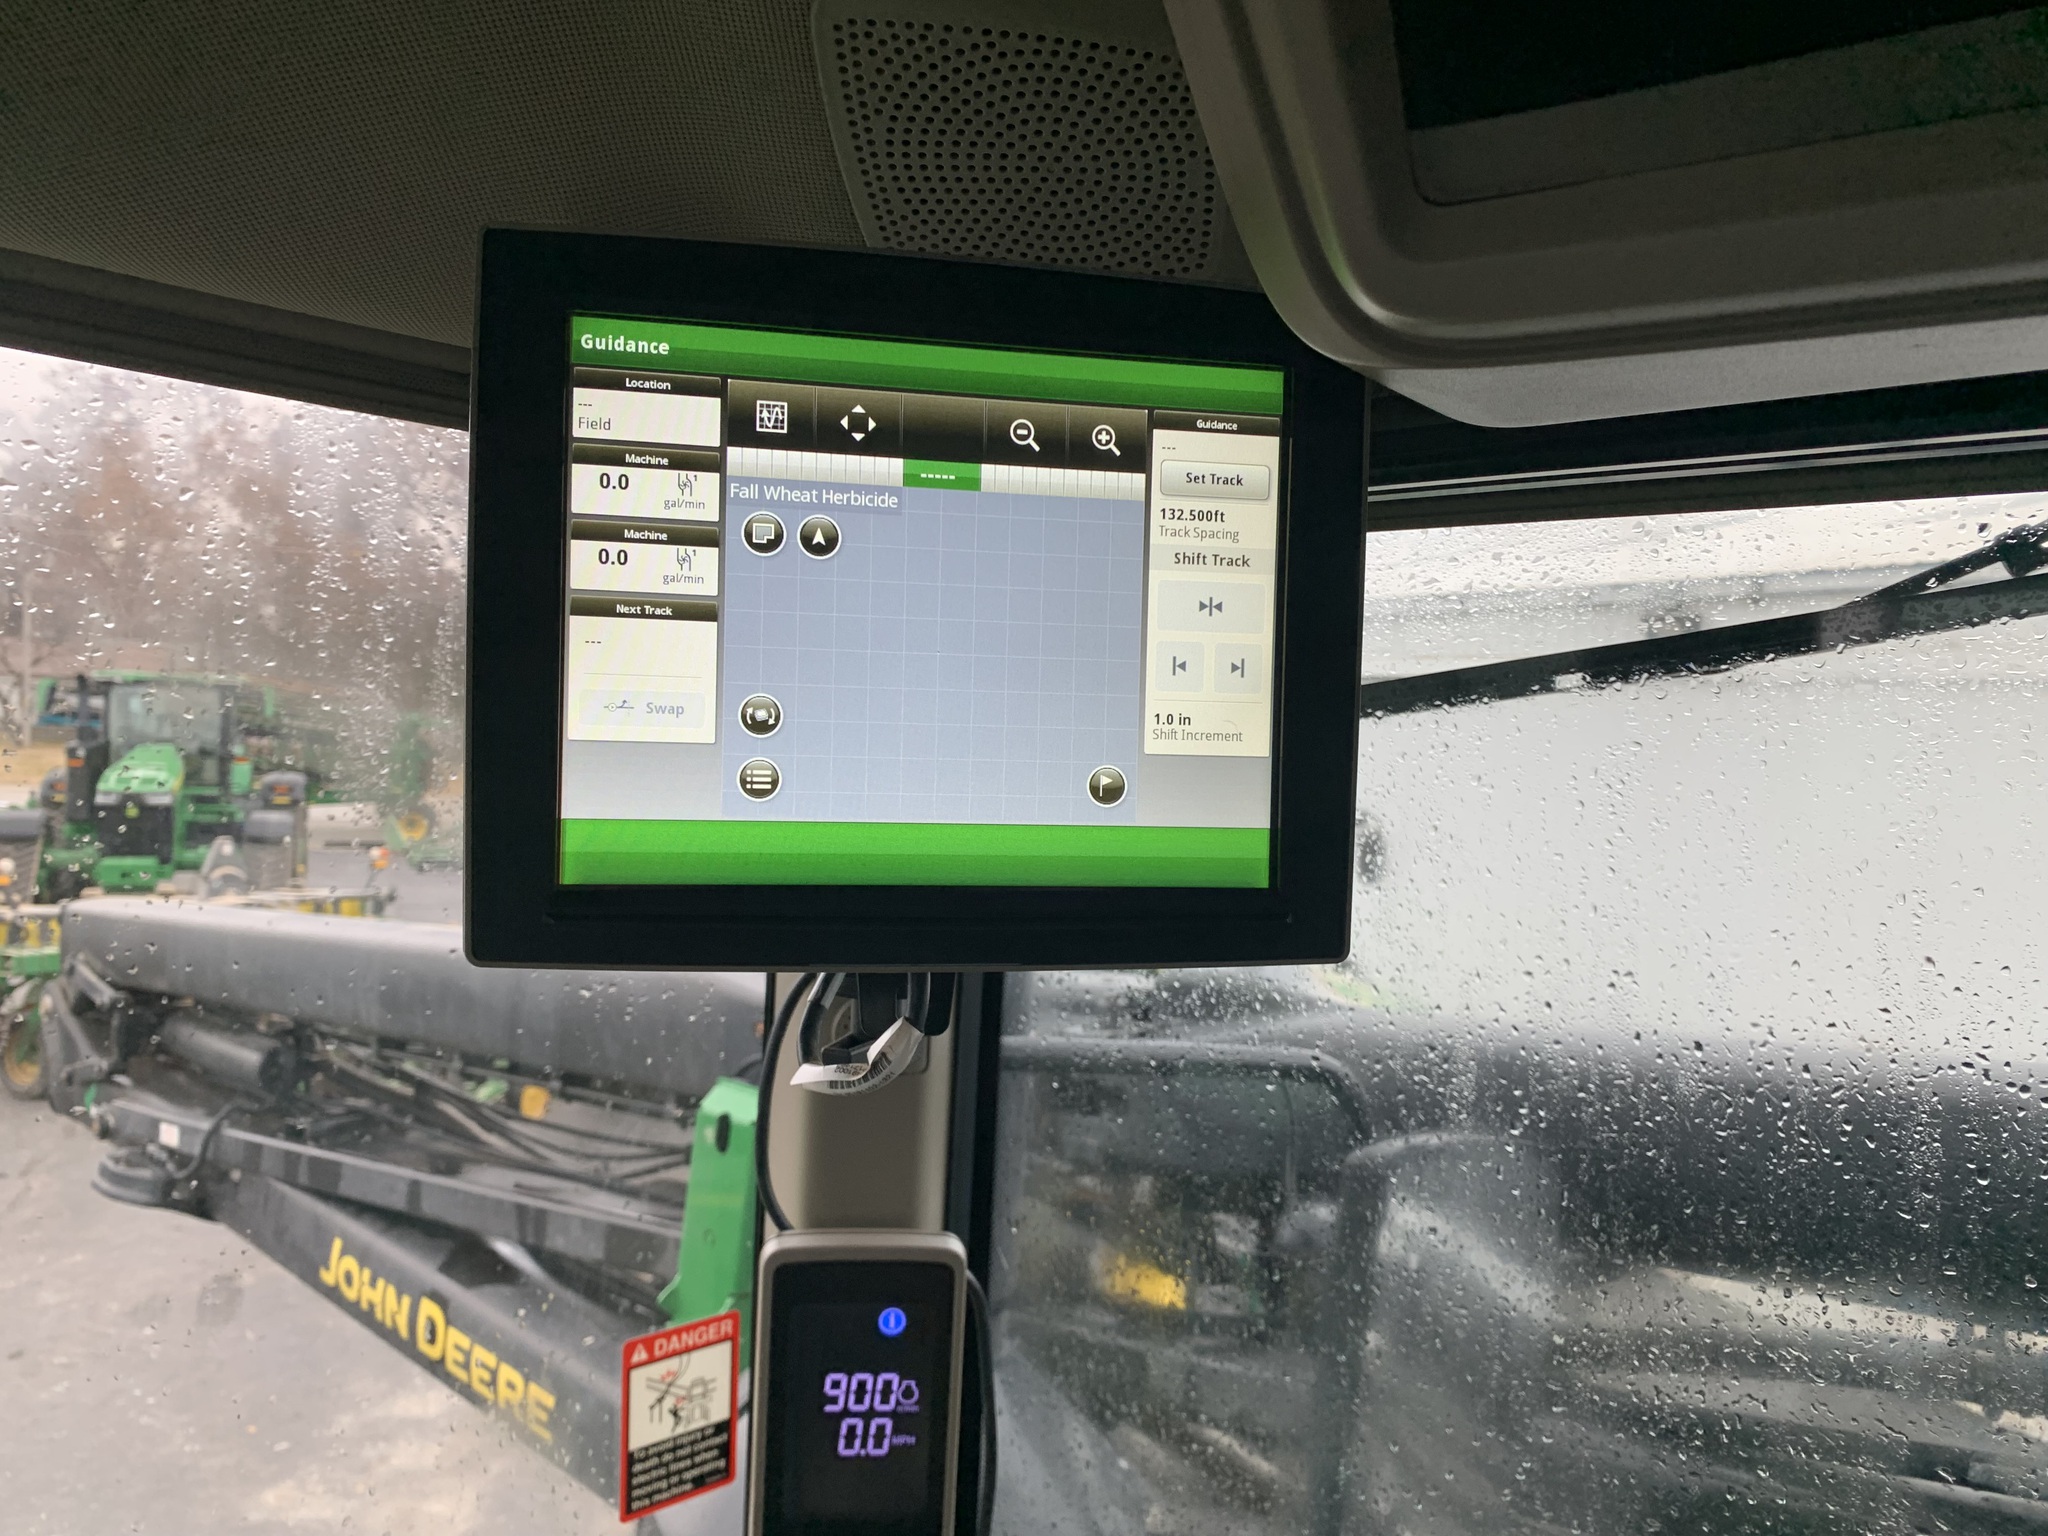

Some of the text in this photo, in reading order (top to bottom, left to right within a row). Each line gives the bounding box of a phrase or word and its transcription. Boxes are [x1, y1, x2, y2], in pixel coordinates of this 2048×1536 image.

[580, 333, 670, 356] Guidance
[625, 378, 671, 391] Location
[578, 416, 611, 431] Field
[1196, 419, 1238, 431] Guidance
[625, 453, 669, 466] Machine
[599, 472, 629, 490] 0.0
[1186, 472, 1243, 486] Set Track
[730, 484, 898, 508] Fall Wheat Herbicide
[663, 498, 705, 511] gal/min
[1160, 508, 1225, 523] 132.500ft
[624, 529, 668, 541] Machine
[1159, 525, 1239, 543] Track Spacing
[598, 548, 628, 566] 0.0
[1174, 552, 1250, 567] Shift Track
[662, 572, 704, 586] gal/min
[616, 604, 672, 616] Next Track
[645, 701, 685, 718] Swap
[1154, 713, 1191, 726] 1.0 in
[1152, 728, 1243, 742] Shift Increment
[319, 1236, 556, 1444] JOHN DEERE
[653, 1319, 733, 1356] DANGER
[823, 1372, 899, 1413] 900
[837, 1417, 893, 1457] 0.0
